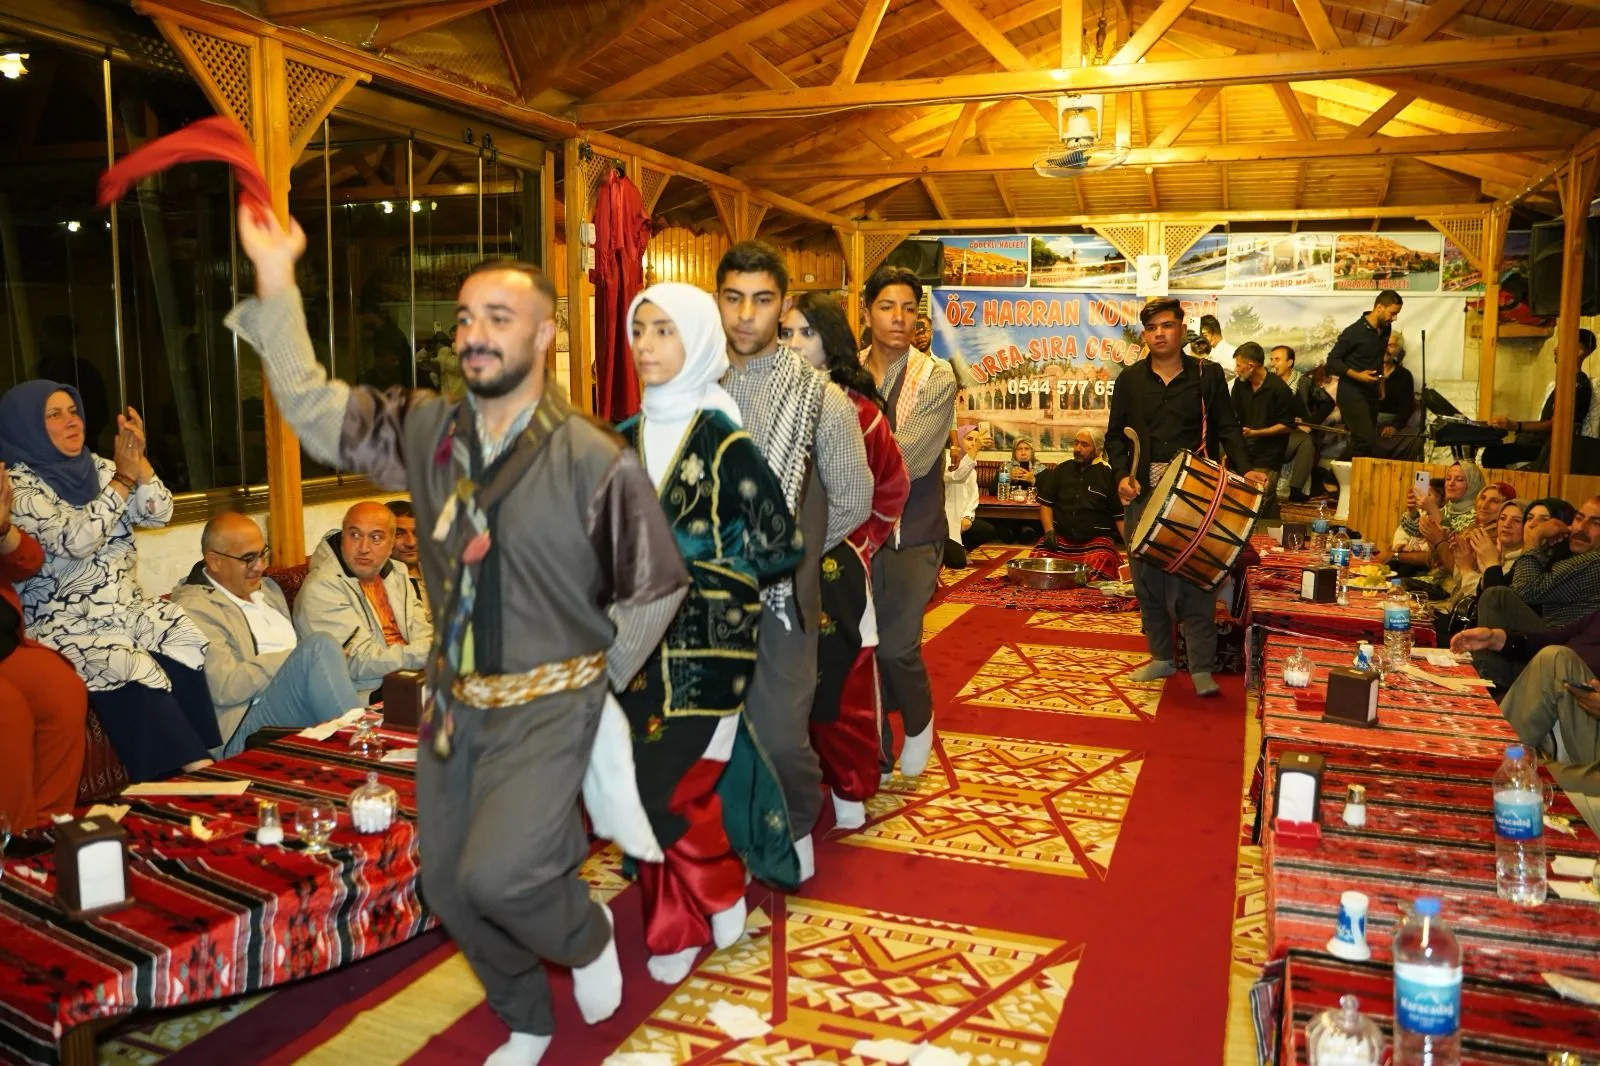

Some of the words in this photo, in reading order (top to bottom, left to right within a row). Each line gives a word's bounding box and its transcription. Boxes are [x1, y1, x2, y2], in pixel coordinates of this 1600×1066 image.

[946, 293, 976, 326] ÖZ
[983, 299, 1080, 327] HARRAN
[1088, 299, 1146, 326] KON
[968, 344, 1025, 384] URFA
[1028, 336, 1078, 361] SIRA
[1084, 336, 1150, 366] GECE
[1007, 380, 1050, 395] 0544
[1056, 380, 1089, 395] 577
[1094, 380, 1116, 395] 65
